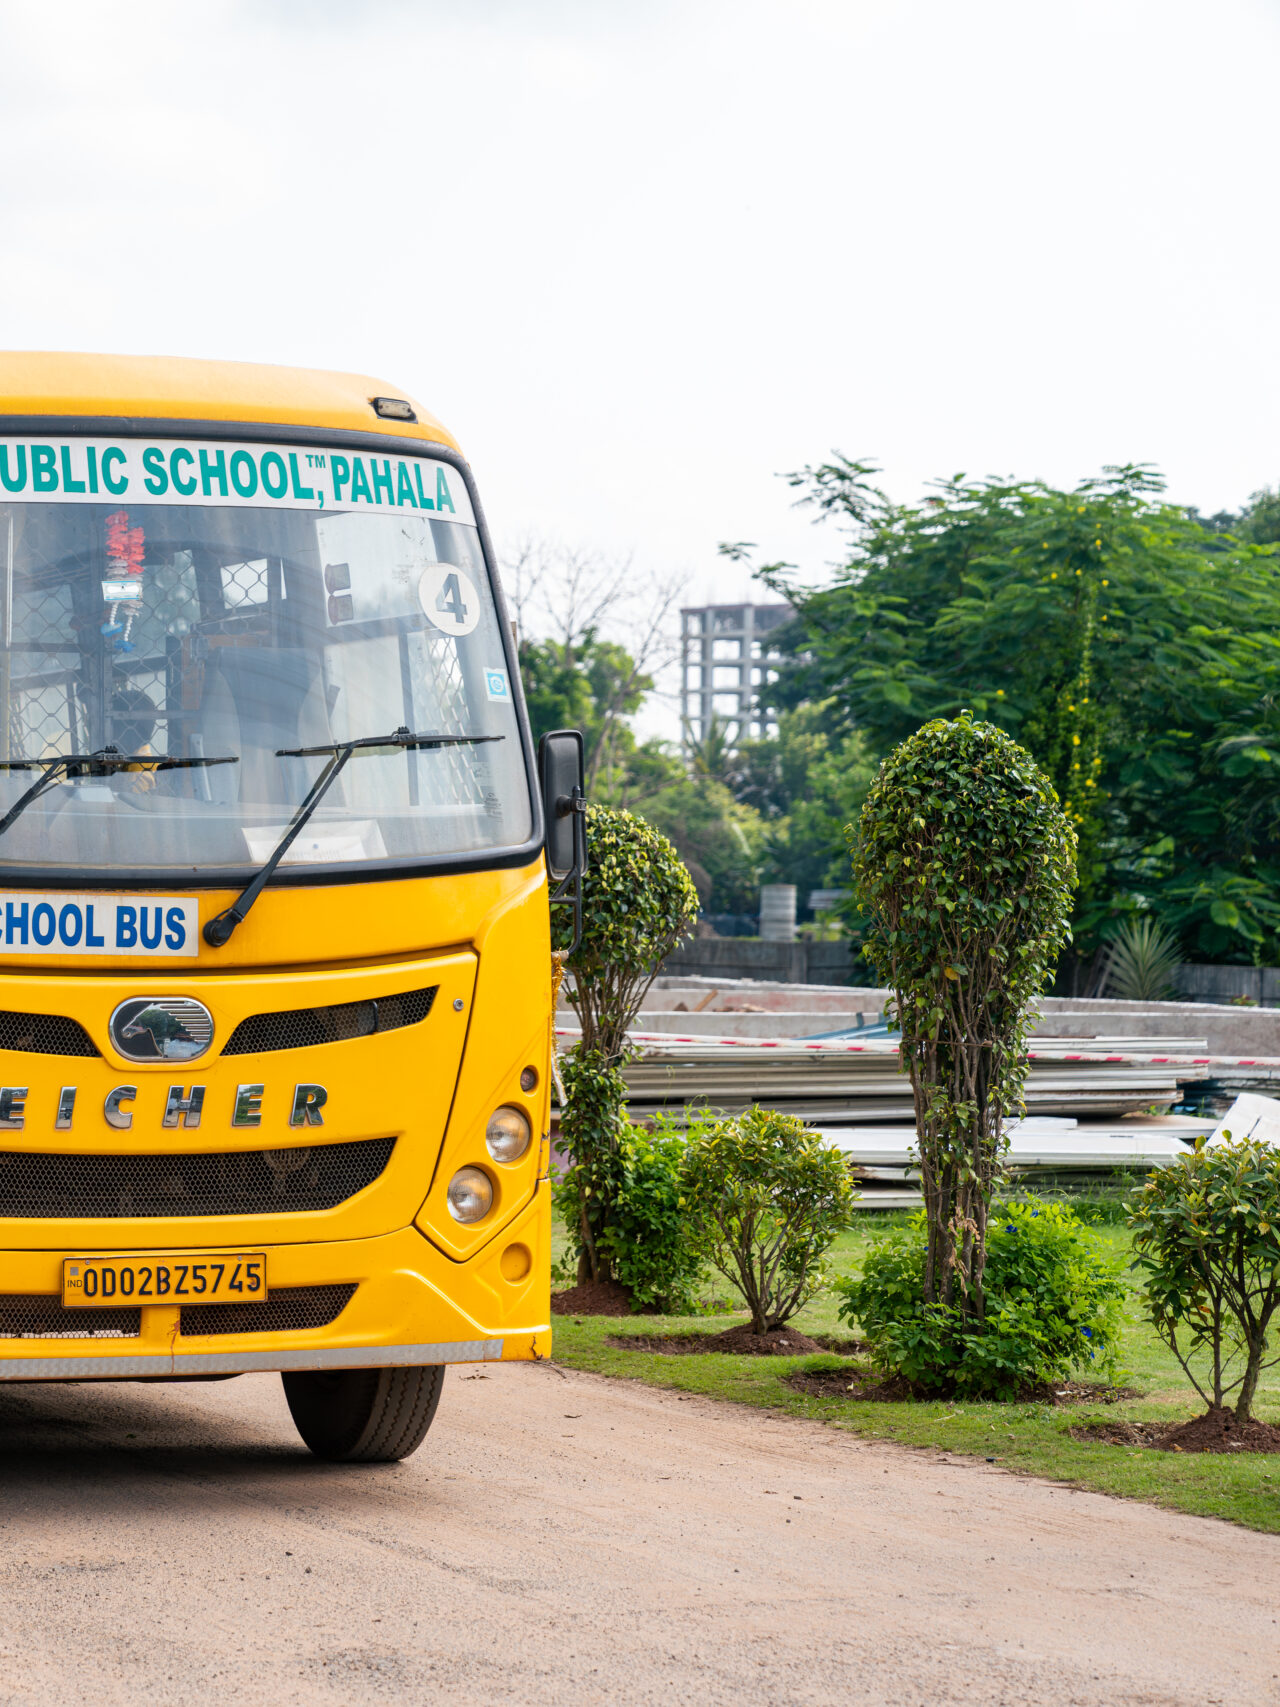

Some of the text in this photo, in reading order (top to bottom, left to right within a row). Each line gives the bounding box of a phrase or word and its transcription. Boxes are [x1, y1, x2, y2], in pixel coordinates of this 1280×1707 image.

[330, 455, 457, 514] PAHALA
[435, 573, 468, 624] 4
[116, 905, 186, 951] BUS
[67, 1280, 83, 1288] IND
